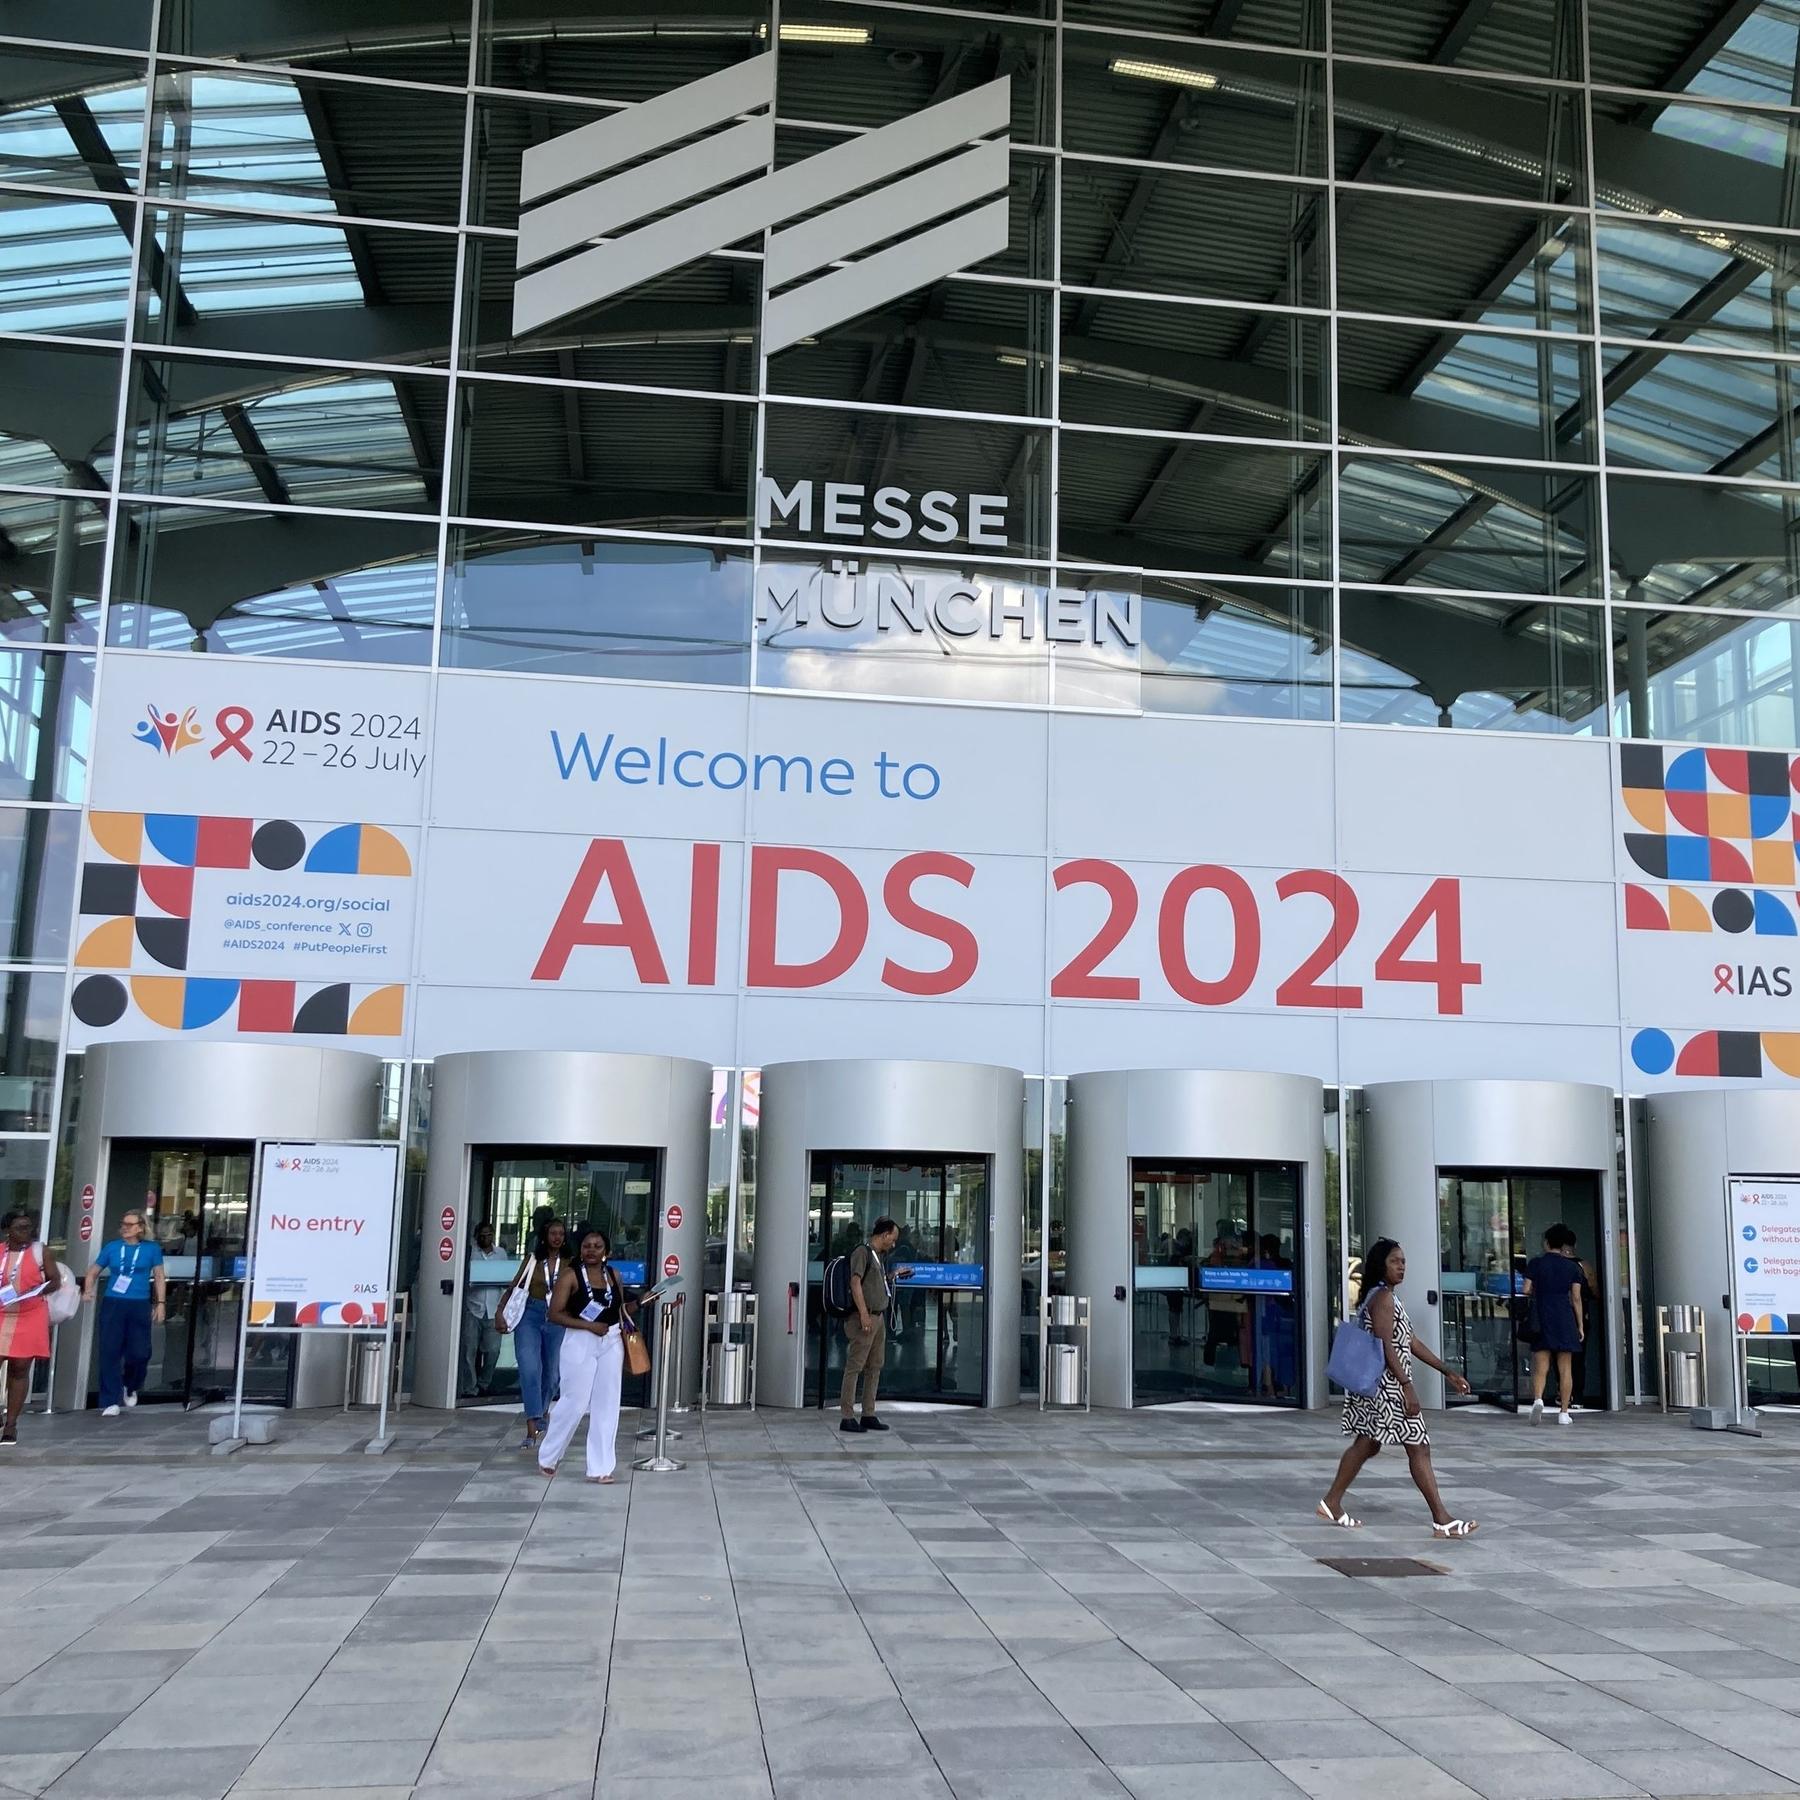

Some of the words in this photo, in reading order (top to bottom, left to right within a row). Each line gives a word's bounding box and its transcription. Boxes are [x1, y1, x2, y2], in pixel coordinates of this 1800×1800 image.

[759, 476, 1009, 547] MESSE
[756, 559, 1143, 647] MÜNCHEN
[266, 708, 341, 736] AIDS
[349, 711, 422, 741] 2024
[261, 739, 296, 767] 22
[322, 742, 358, 769] 26
[364, 745, 427, 779] July
[549, 729, 856, 796] Welcome
[873, 751, 942, 801] to
[226, 891, 391, 913] aids2024.org/social
[223, 918, 333, 934] @AIDS_conference
[530, 837, 980, 996] AIDS
[1050, 857, 1483, 1015] 2024
[223, 938, 286, 951] #AIDS2024
[293, 941, 388, 956] #PutPeopleFirst
[1737, 964, 1793, 998] IAS
[270, 1214, 300, 1231] No
[306, 1215, 366, 1237] entry
[1764, 1267, 1781, 1275] with
[361, 1283, 378, 1294] IAS
